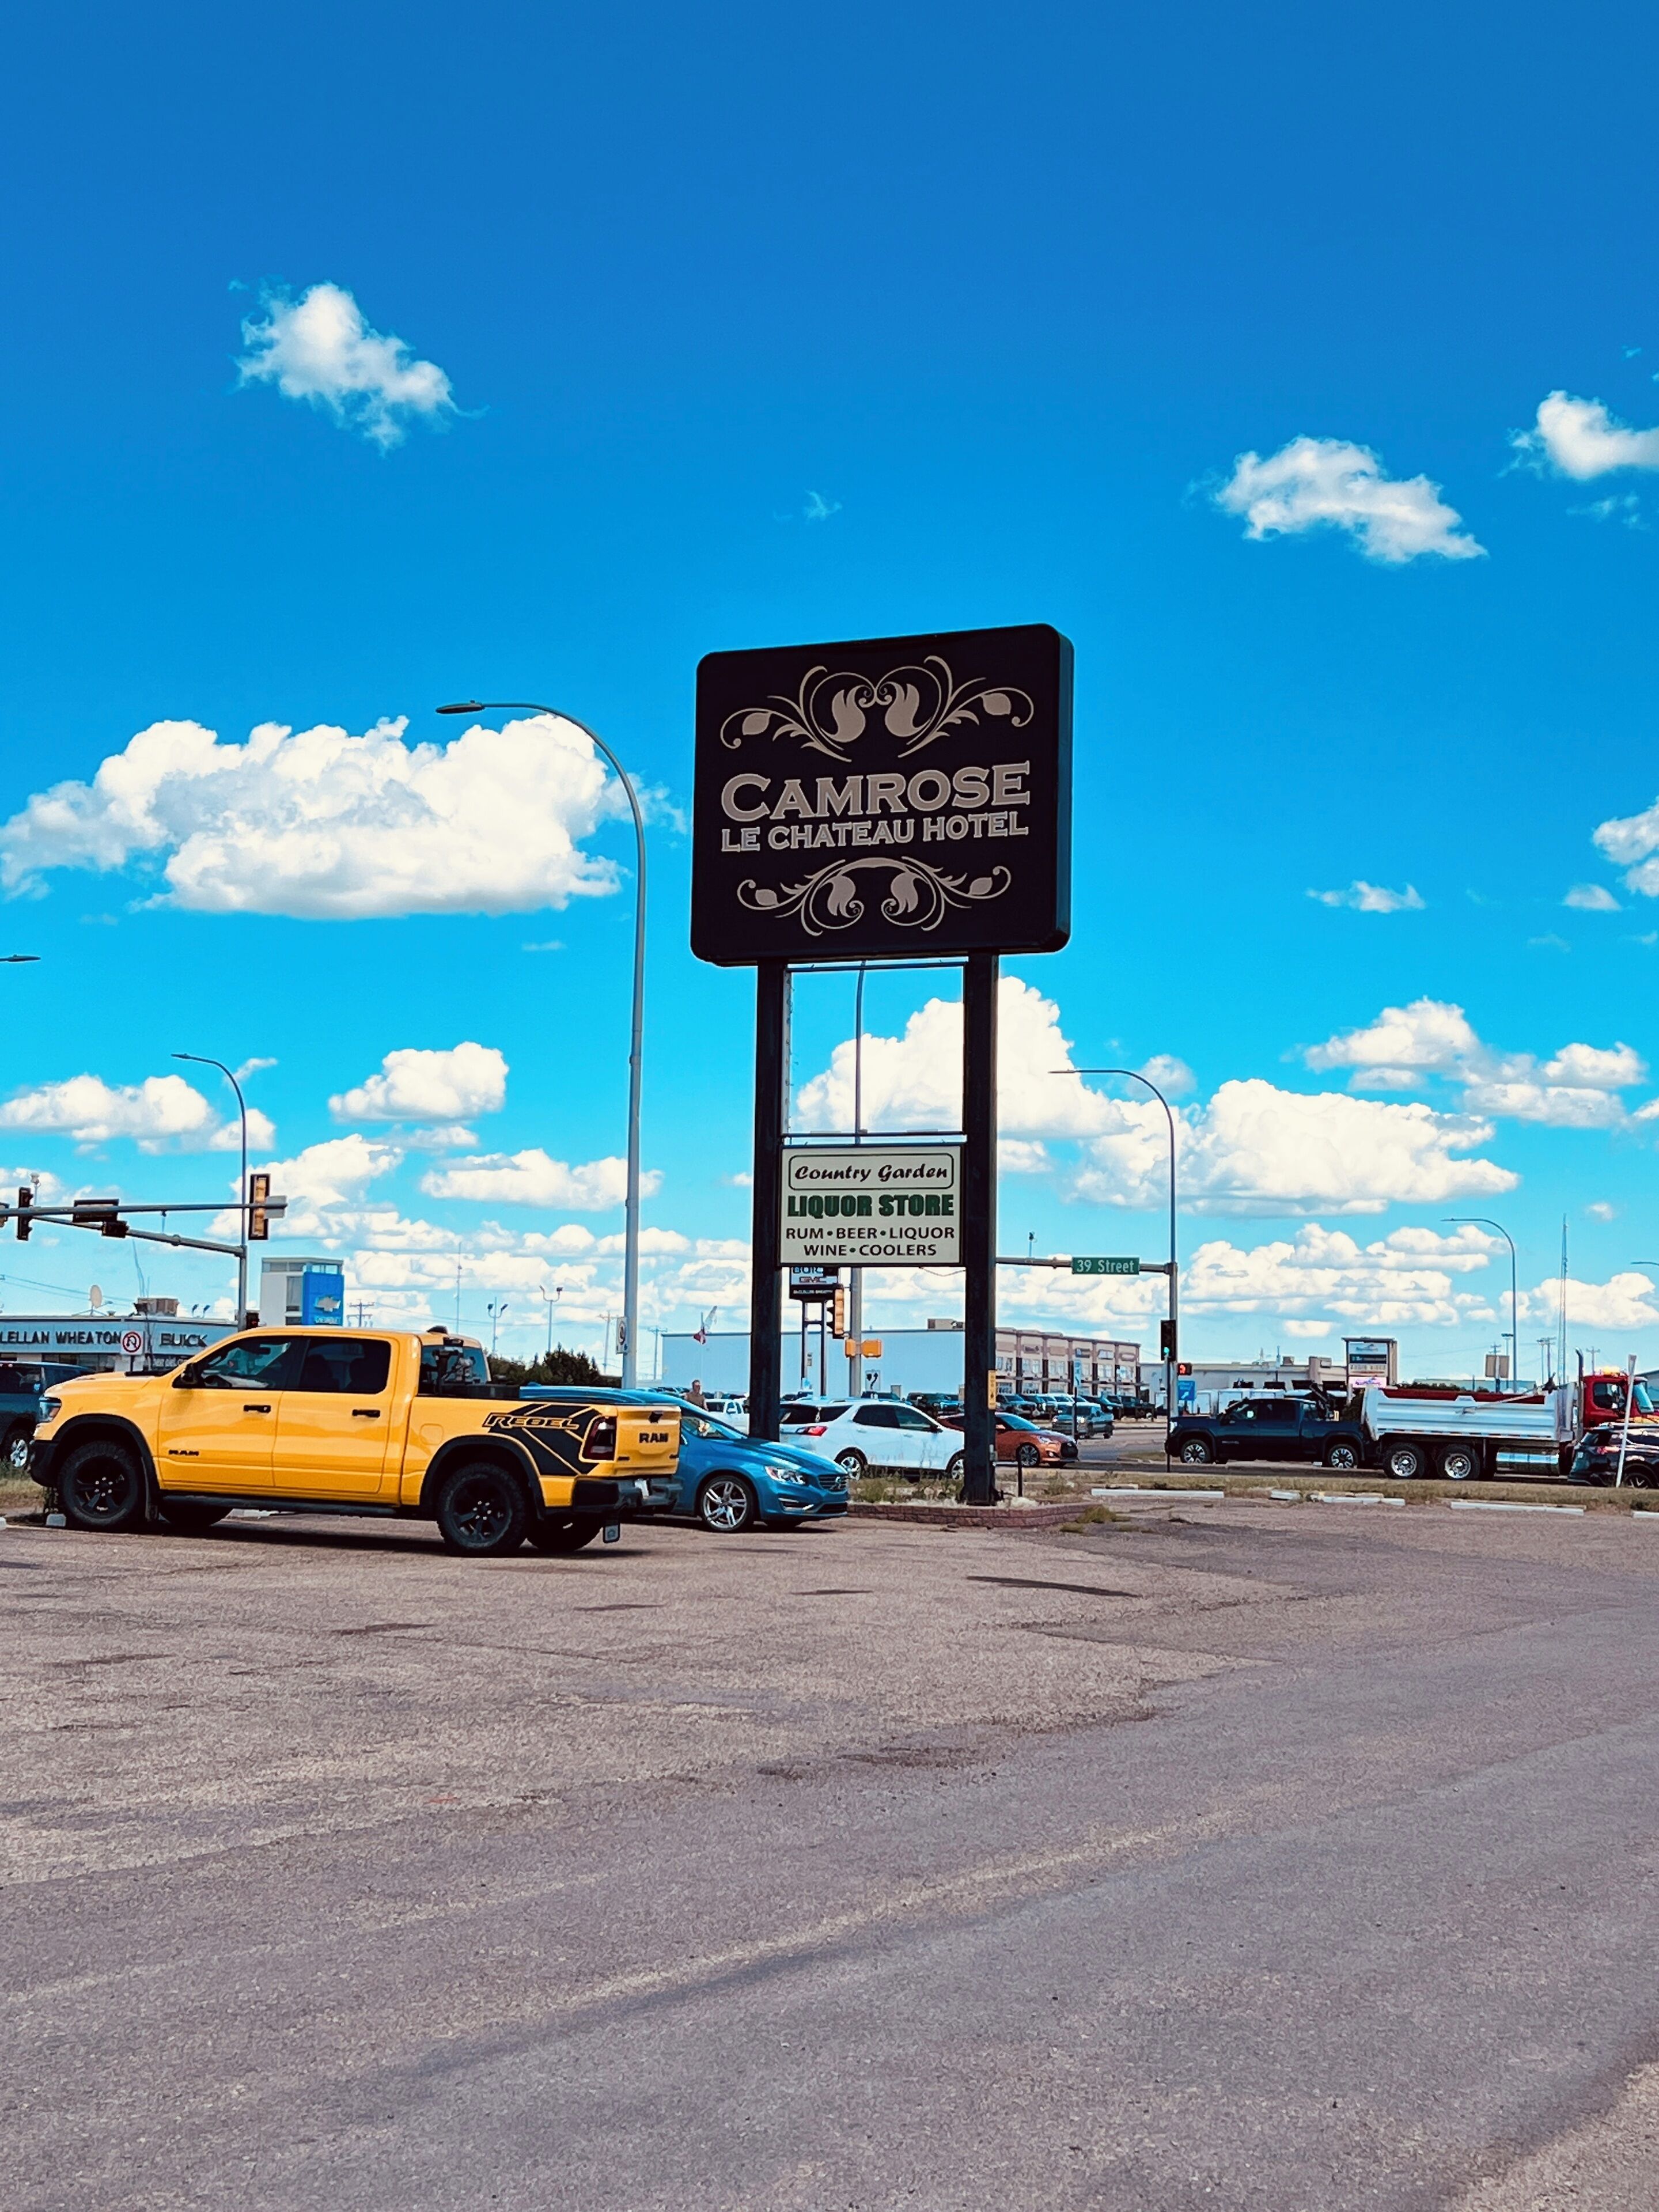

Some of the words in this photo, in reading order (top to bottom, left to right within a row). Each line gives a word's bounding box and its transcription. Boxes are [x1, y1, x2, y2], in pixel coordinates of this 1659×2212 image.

[721, 760, 1030, 822] CAMROSE
[721, 827, 760, 852] LE
[768, 819, 915, 850] CHATEAU
[923, 812, 1029, 842] HOTEL
[794, 1165, 872, 1182] Country
[878, 1164, 948, 1182] Garden
[787, 1195, 873, 1219] LIQUOR
[878, 1194, 954, 1217] STORE
[786, 1228, 824, 1239] RUM
[836, 1228, 877, 1238] BEER
[890, 1227, 955, 1240] LIQUOR
[804, 1244, 847, 1256] WINE
[859, 1244, 937, 1256] COOLERS
[1077, 1259, 1092, 1272] 39
[1097, 1259, 1135, 1273] Street
[55, 1331, 122, 1344] WHEATON
[160, 1333, 208, 1347] BUICK
[482, 1412, 579, 1429] REBEL
[639, 1433, 669, 1444] RAM
